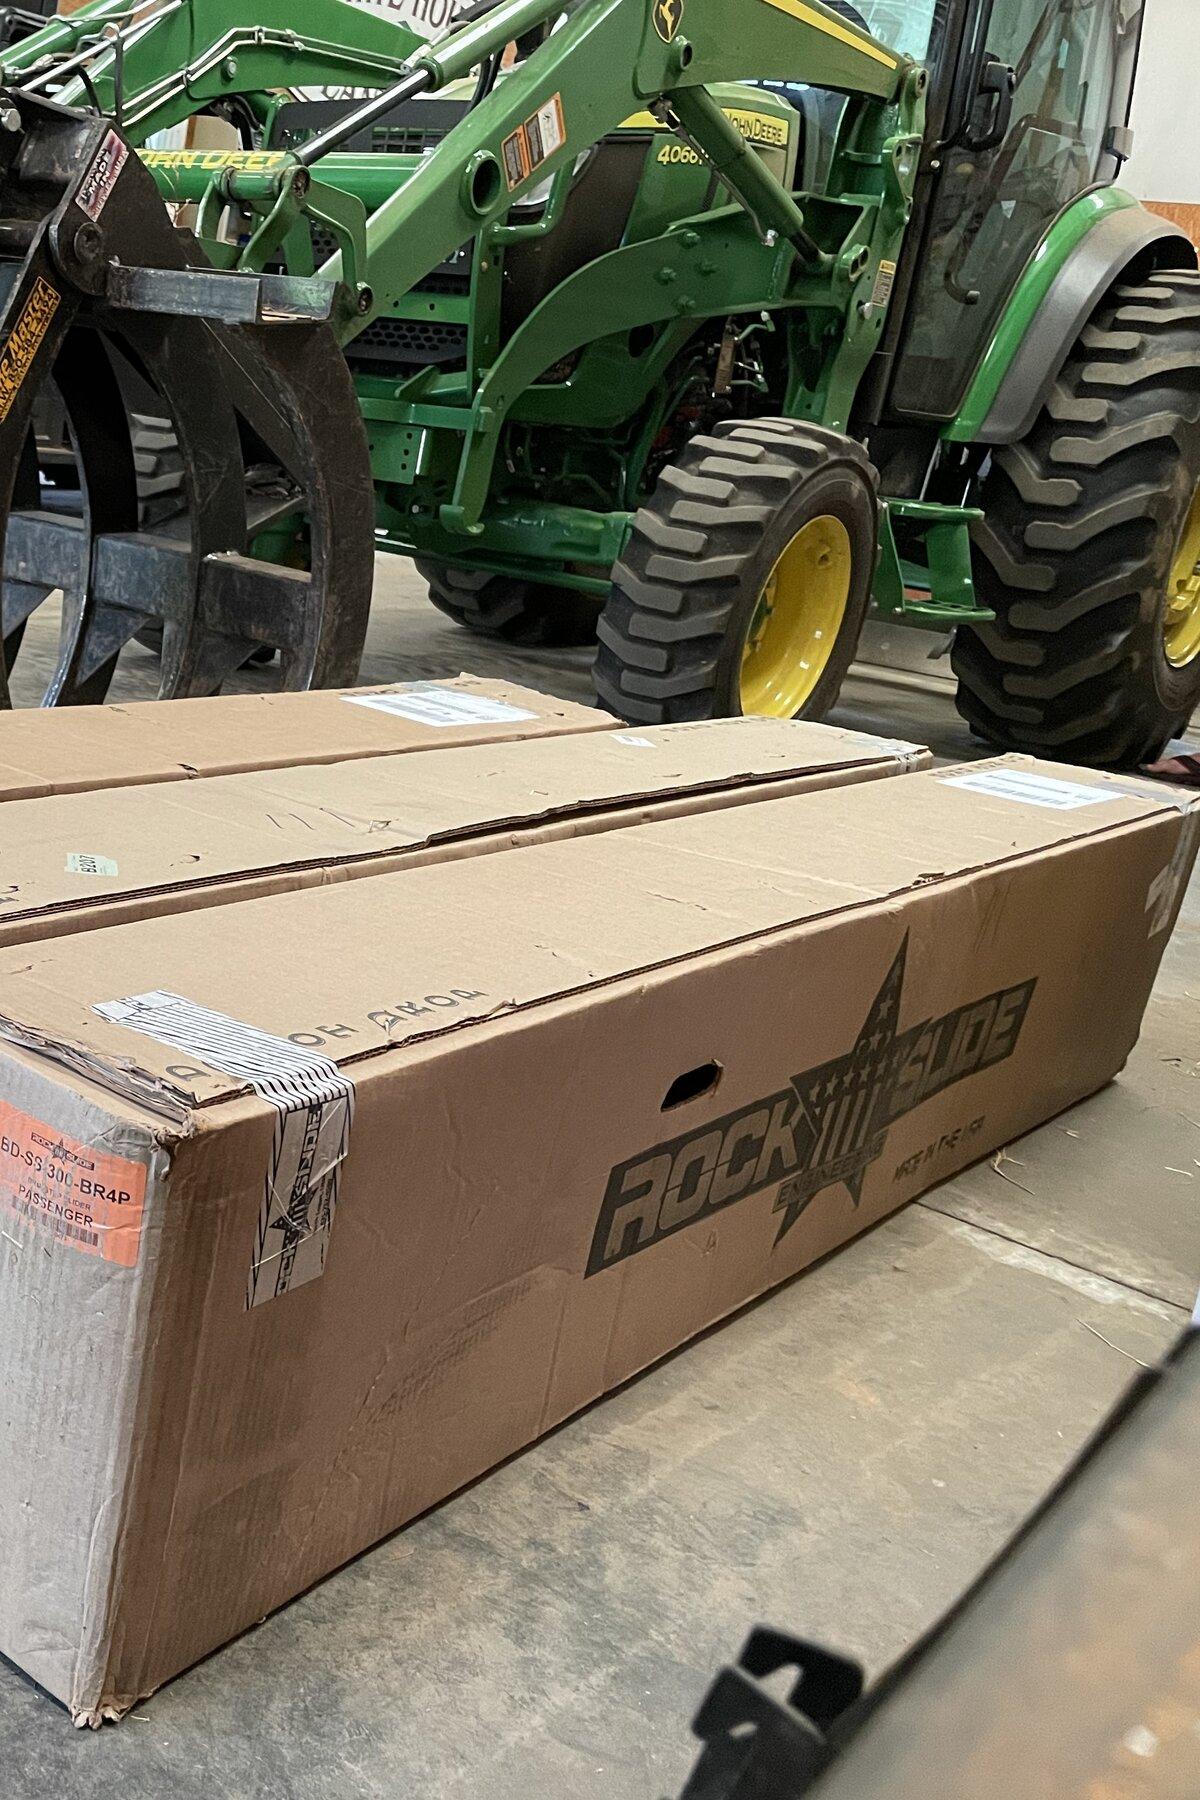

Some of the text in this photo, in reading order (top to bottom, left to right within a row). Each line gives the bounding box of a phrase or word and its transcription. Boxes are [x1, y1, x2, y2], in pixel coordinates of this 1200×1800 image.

[657, 145, 703, 165] 4066
[754, 118, 782, 142] DEERE
[137, 150, 200, 168] OHN
[8, 280, 48, 361] Master
[166, 989, 490, 1082] D OT DROP
[602, 985, 1028, 1262] ROCK SLIDE
[0, 1135, 131, 1206] BD-SS300-BR4P
[18, 1184, 94, 1228] PASSENGER
